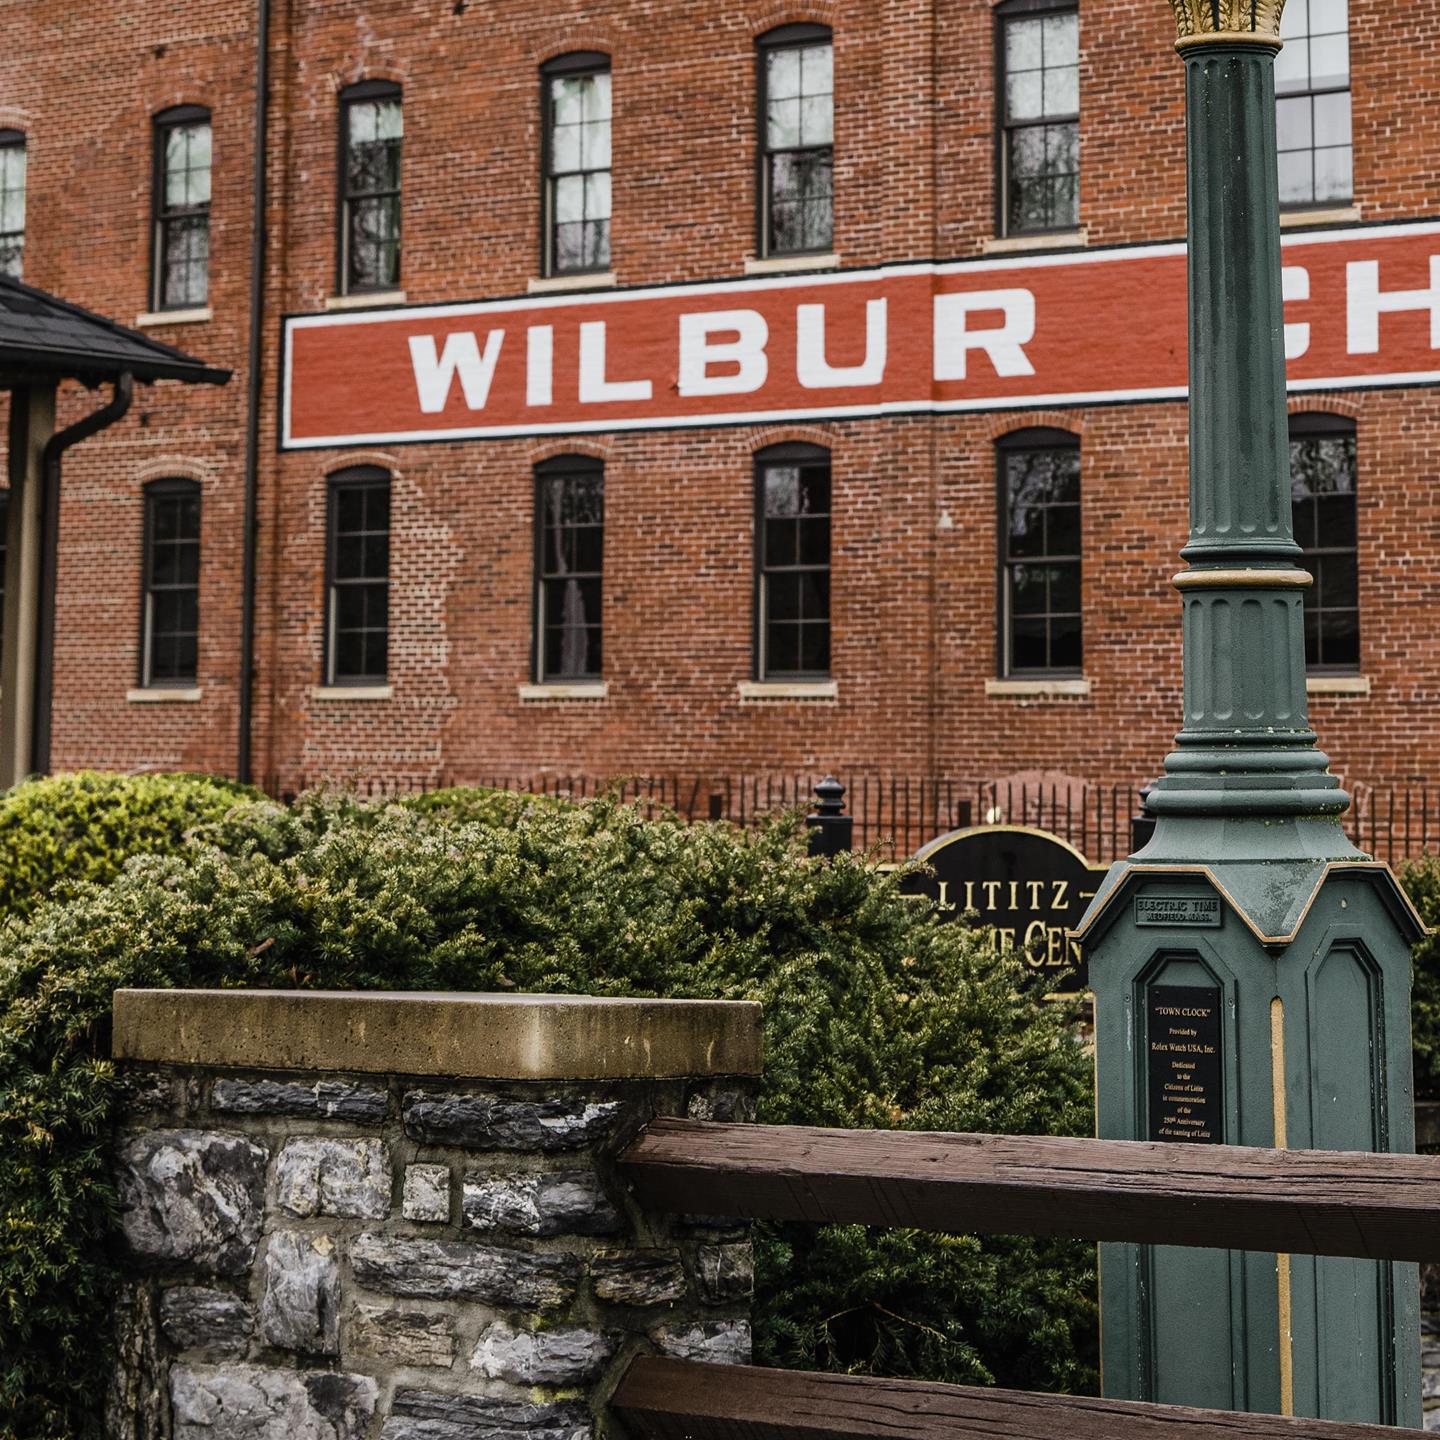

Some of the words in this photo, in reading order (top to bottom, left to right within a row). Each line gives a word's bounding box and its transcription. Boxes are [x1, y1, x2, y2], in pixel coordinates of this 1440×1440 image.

[408, 287, 1037, 414] WILBUR
[938, 881, 1069, 910] LITITZ
[1138, 901, 1188, 911] ELECTRIC
[1192, 901, 1217, 912] TIME
[1190, 1029, 1197, 1037] by
[1151, 1042, 1168, 1051] Rolex
[1169, 1043, 1186, 1052] Watch
[1187, 1044, 1203, 1053] USA,
[1204, 1045, 1215, 1053] Inc.
[1172, 1061, 1196, 1069] Dedicated
[1164, 1083, 1183, 1091] Citizens
[1176, 1118, 1205, 1127] Anniversary
